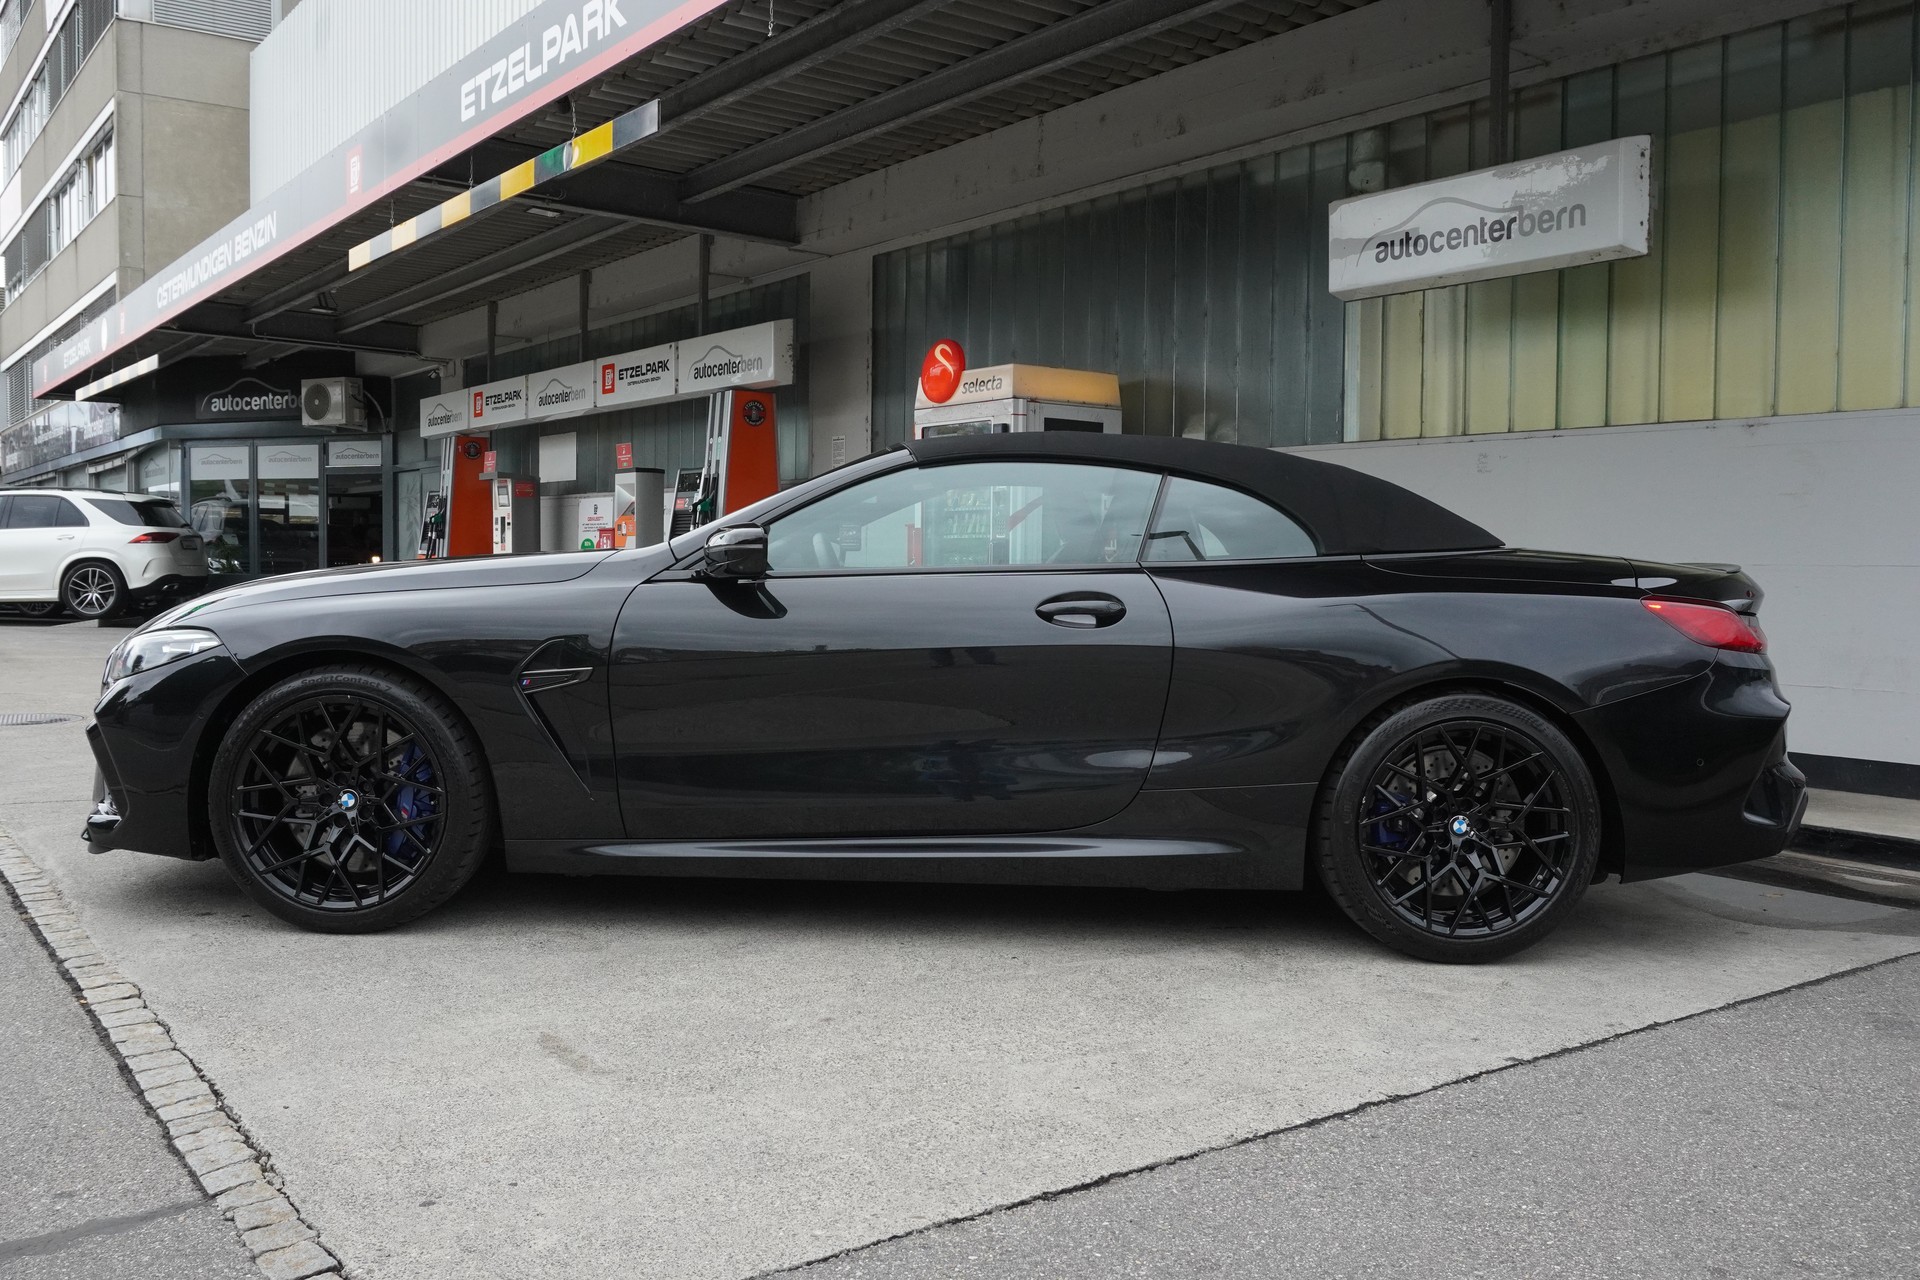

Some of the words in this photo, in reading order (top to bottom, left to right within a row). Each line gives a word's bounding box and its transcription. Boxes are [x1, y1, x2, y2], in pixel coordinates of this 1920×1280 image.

[461, 0, 627, 122] ETZELPARK
[1374, 203, 1587, 263] autocenterbern
[157, 240, 232, 308] OSTERMUNDIGEN
[235, 210, 276, 262] BENZIN
[618, 359, 670, 381] ETZELPARK
[694, 356, 763, 380] autocenterbern
[961, 375, 1003, 394] selecta
[485, 389, 522, 406] ETZELPARK
[538, 388, 586, 407] autocenterbern
[427, 411, 463, 427] autocenterbern
[684, 498, 690, 507] 2
